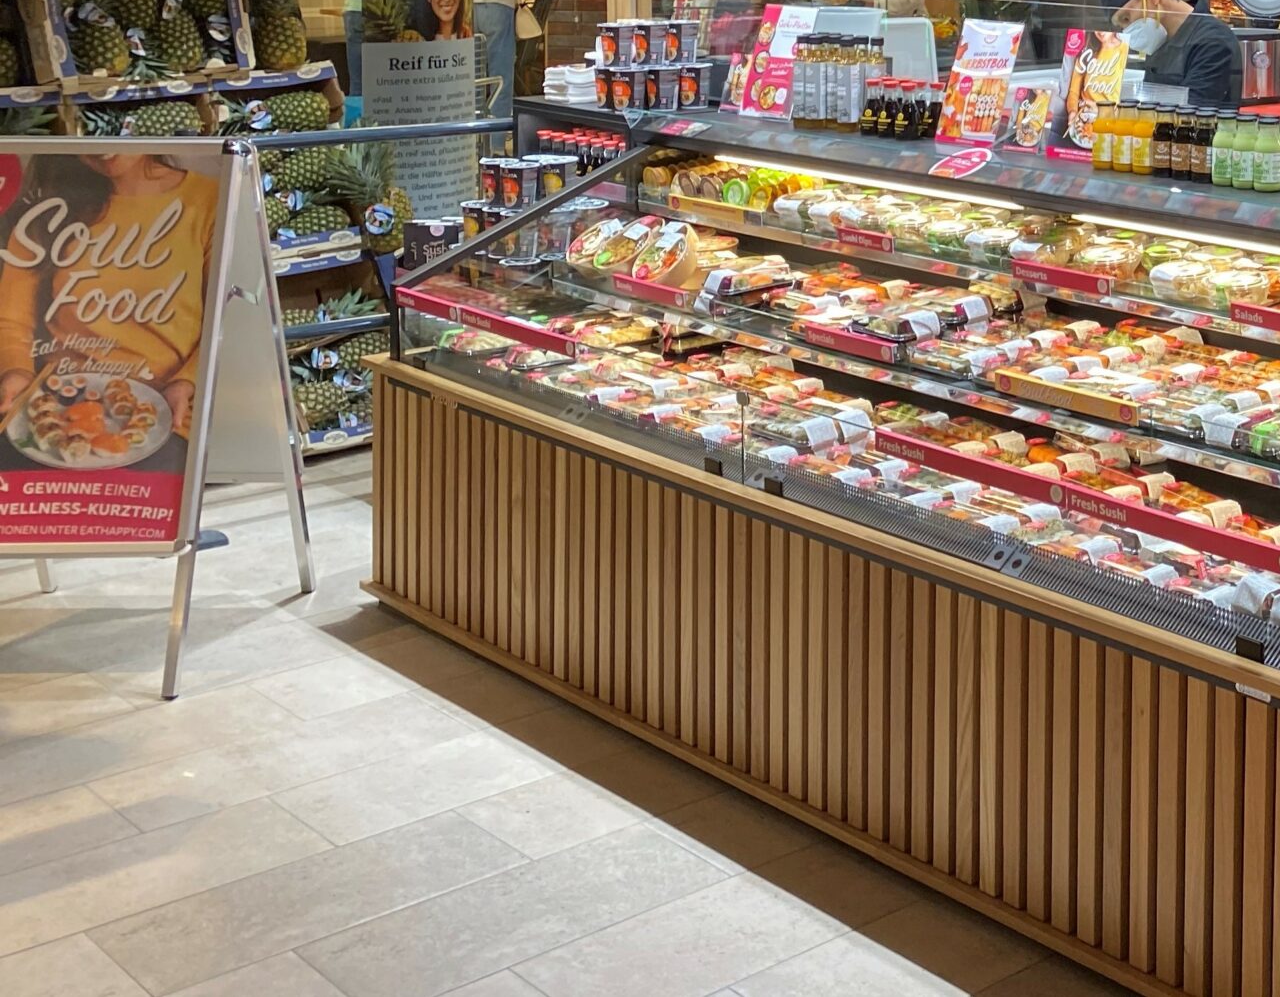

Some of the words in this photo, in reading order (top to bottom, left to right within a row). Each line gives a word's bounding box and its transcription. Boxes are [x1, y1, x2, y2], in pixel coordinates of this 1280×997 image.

[389, 56, 423, 71] Reif
[428, 54, 449, 69] für
[1075, 48, 1120, 77] Soul
[376, 77, 411, 87] Unsere
[412, 76, 436, 85] extra
[1083, 74, 1117, 93] Food
[0, 197, 184, 269] Soul
[1015, 266, 1048, 281] Desserts
[45, 270, 188, 325] Food
[1234, 308, 1263, 324] Salads
[807, 330, 835, 345] Specials
[30, 338, 58, 358] Eat
[57, 357, 76, 375] Be
[81, 353, 146, 378] happy!
[878, 438, 901, 453] Fresh
[901, 443, 925, 462] Sushi
[23, 482, 103, 495] GEWINNE
[104, 483, 151, 499] EINEN
[1071, 494, 1098, 514] Fresh
[1099, 503, 1127, 523] Sushi
[40, 525, 80, 536] UNTER
[80, 525, 166, 539] EATHAPPY.COM
